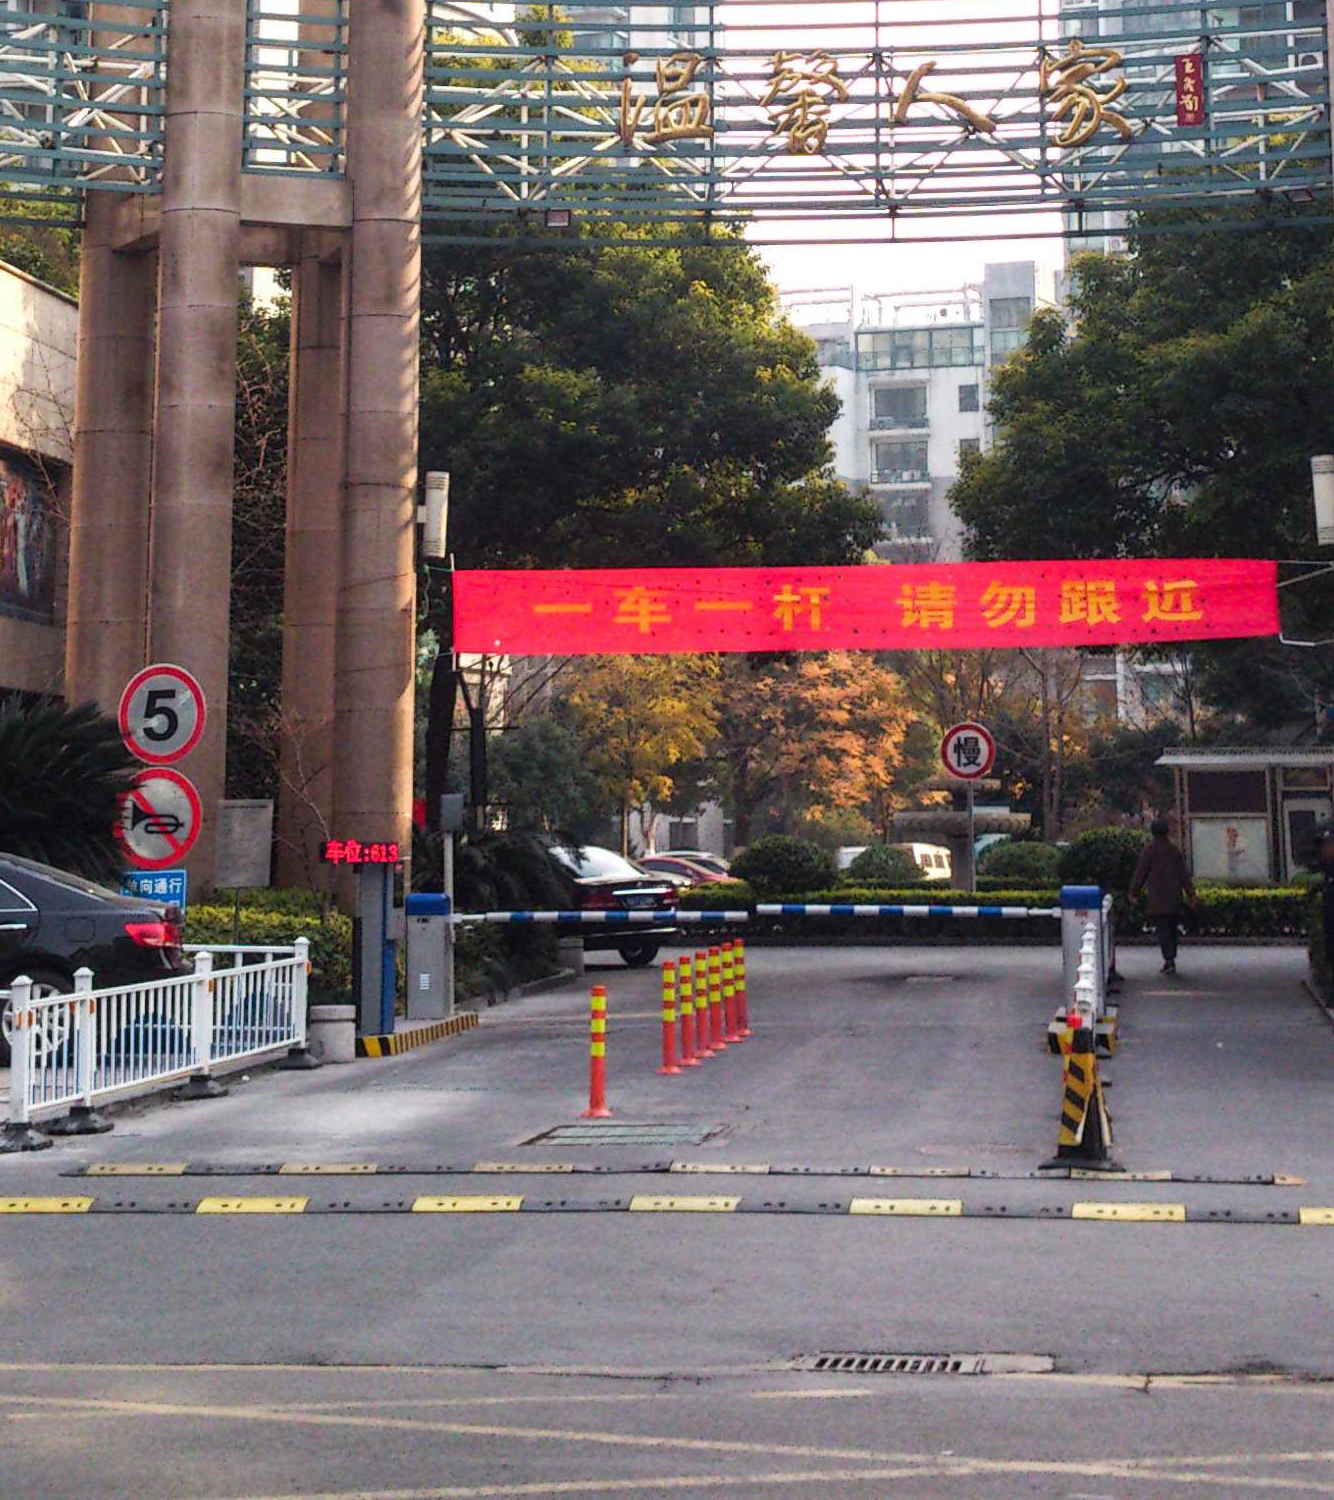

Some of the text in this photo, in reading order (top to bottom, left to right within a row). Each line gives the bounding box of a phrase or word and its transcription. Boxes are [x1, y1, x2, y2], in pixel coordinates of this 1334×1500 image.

[533, 580, 1204, 634] 一车一杆 请勿跟近
[143, 689, 178, 742] 5
[954, 736, 981, 768] 慢
[325, 840, 399, 864] 车位:613
